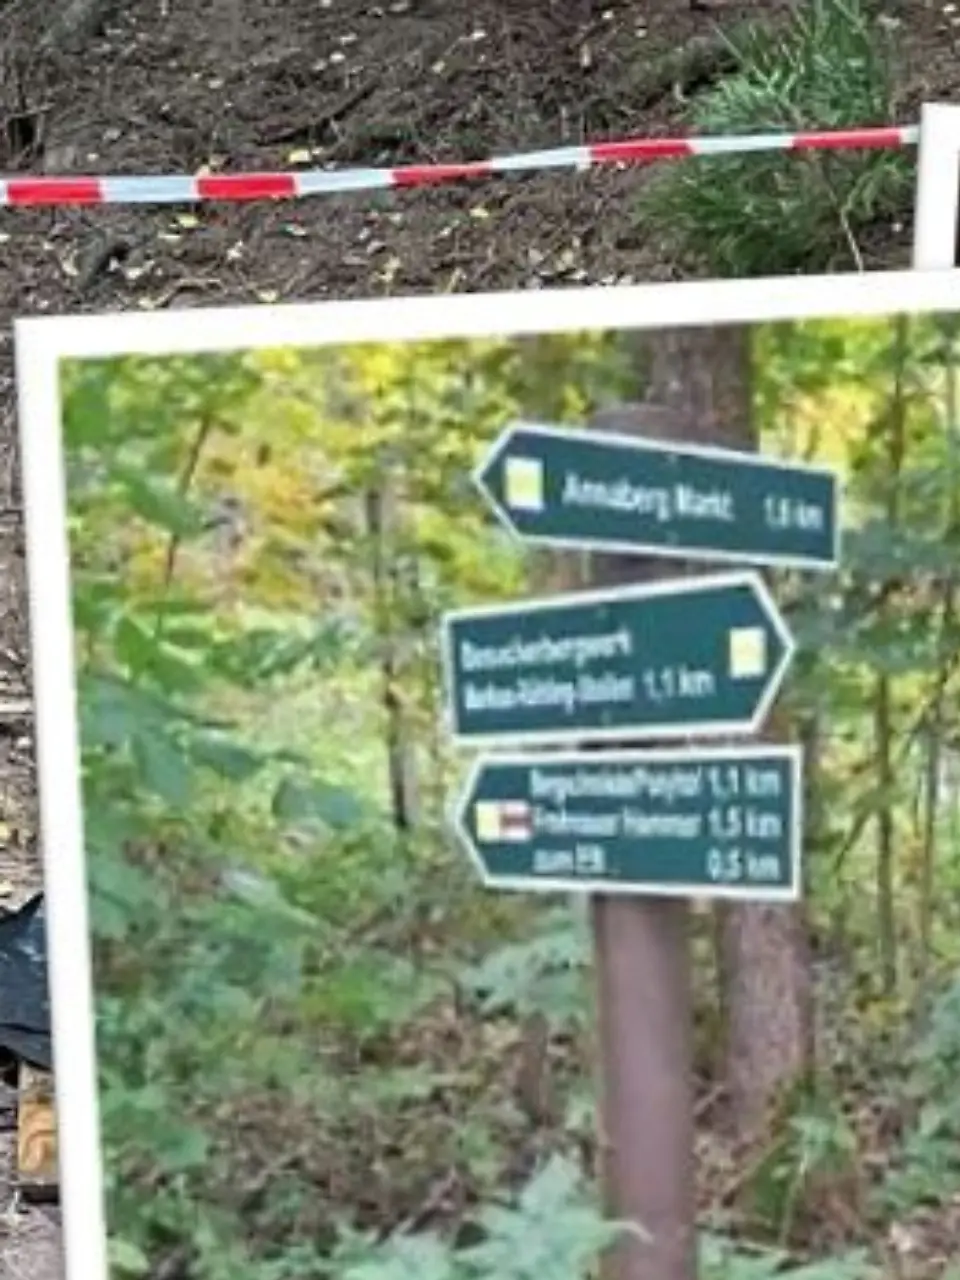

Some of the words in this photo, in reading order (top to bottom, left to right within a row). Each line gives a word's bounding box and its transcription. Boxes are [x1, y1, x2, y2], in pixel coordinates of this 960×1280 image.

[675, 482, 735, 521] Markt
[795, 499, 824, 531] km
[643, 670, 676, 702] 1,1
[678, 668, 716, 699] km
[746, 765, 781, 796] km
[746, 807, 782, 839] km
[746, 850, 781, 880] km
